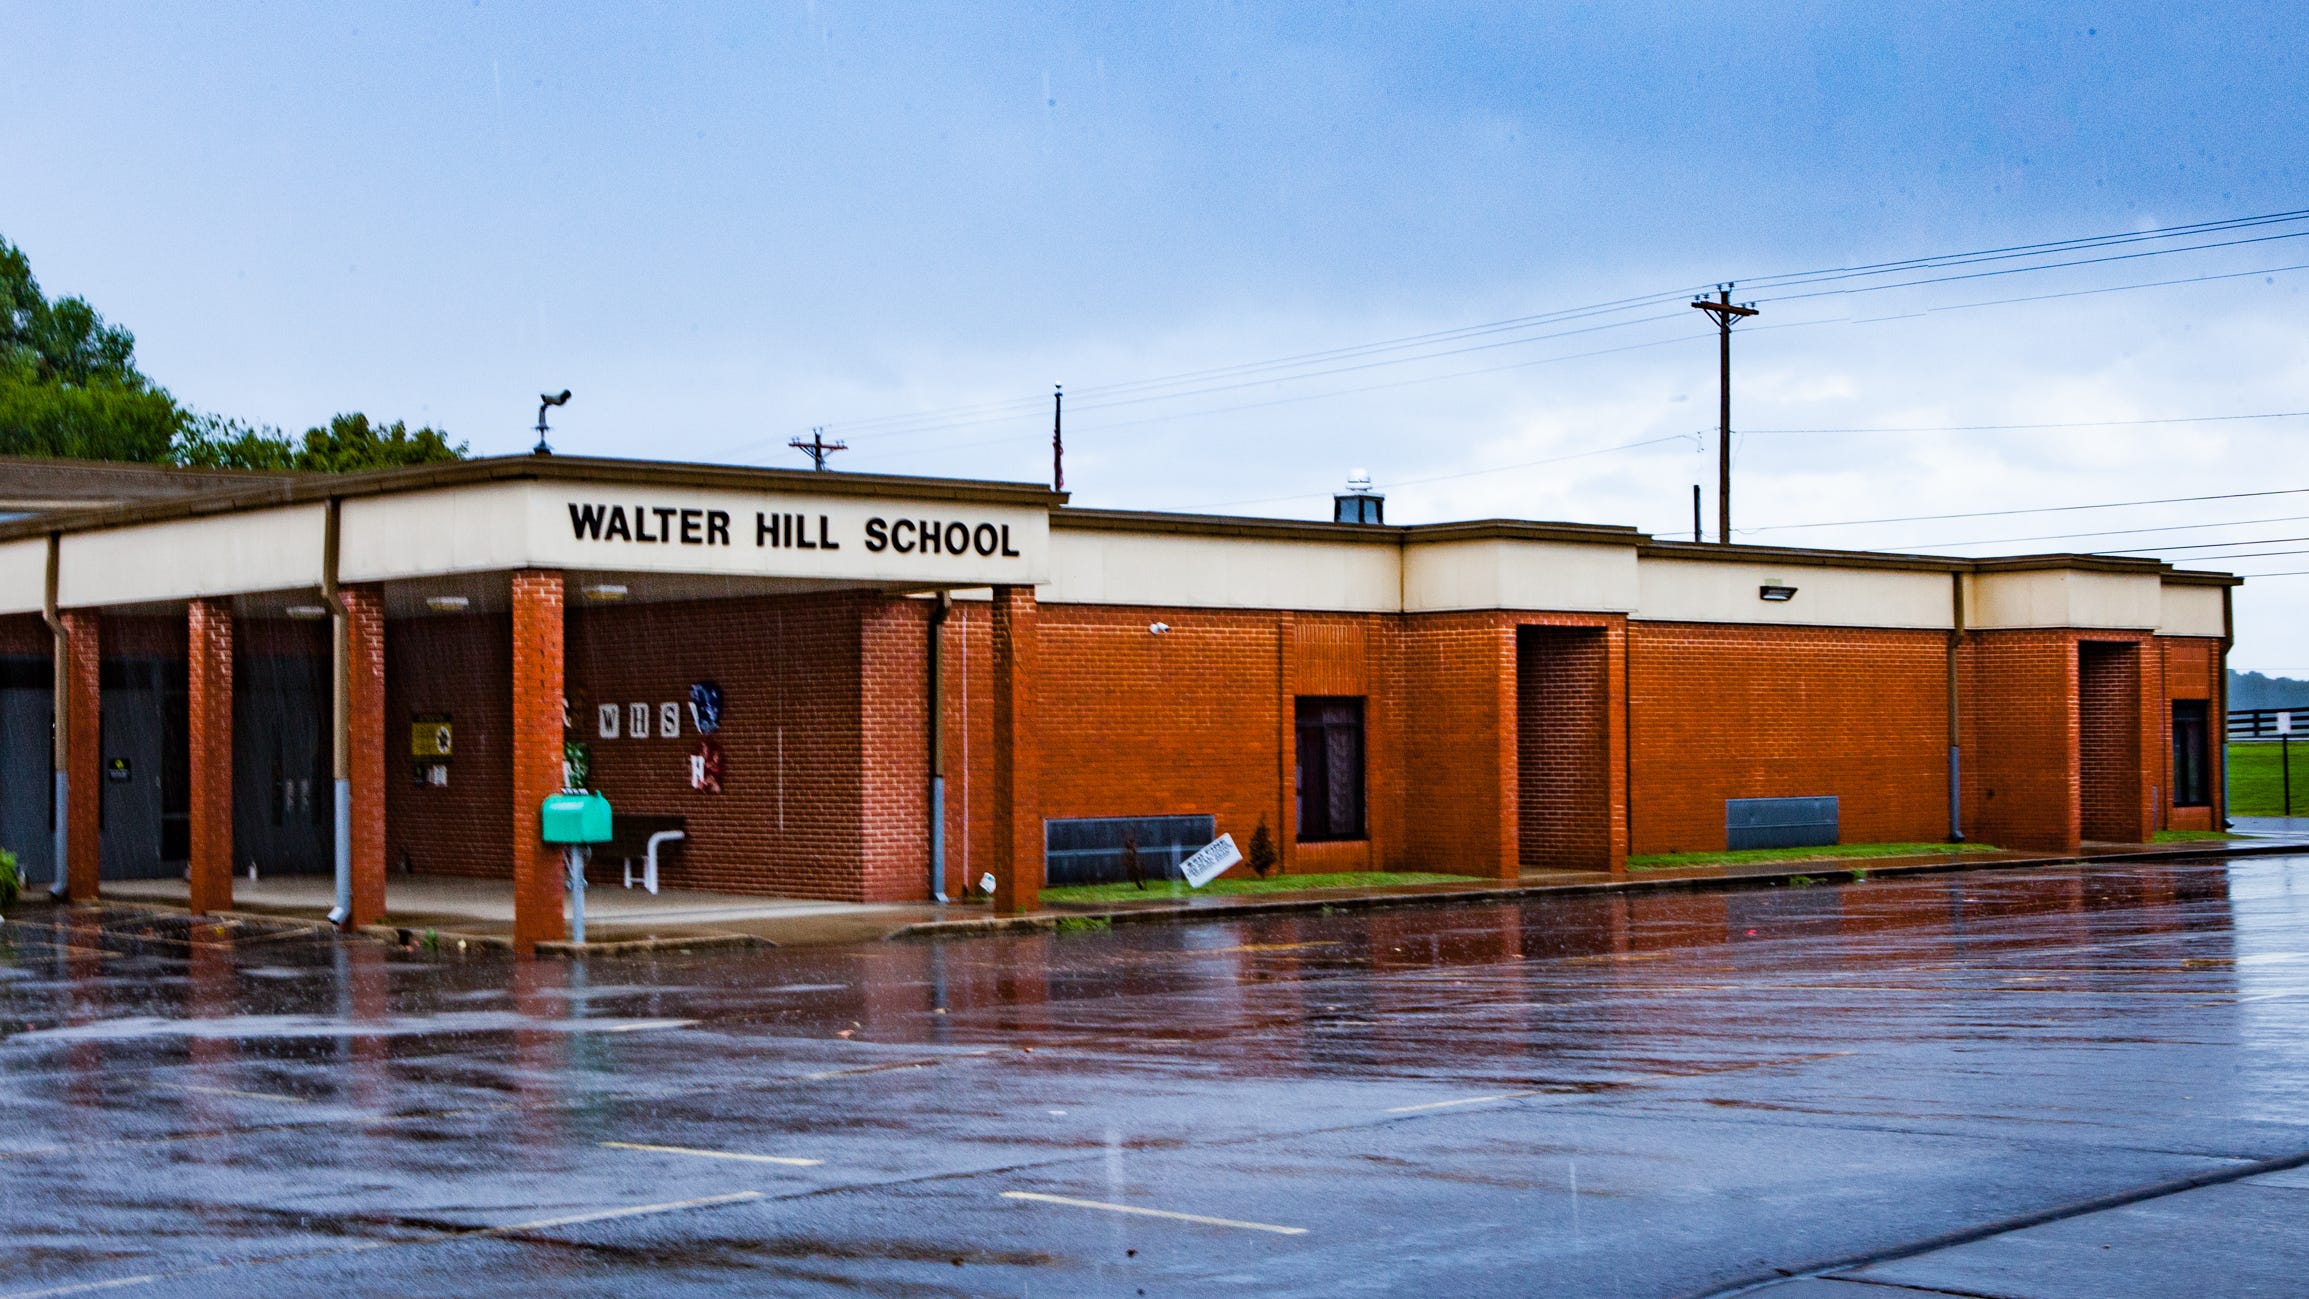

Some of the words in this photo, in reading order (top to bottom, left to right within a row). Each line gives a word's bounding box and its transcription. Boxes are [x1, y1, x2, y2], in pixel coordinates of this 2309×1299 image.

[568, 503, 730, 546] WALTER
[756, 512, 839, 550] HILL
[865, 517, 1020, 557] SCHOOL
